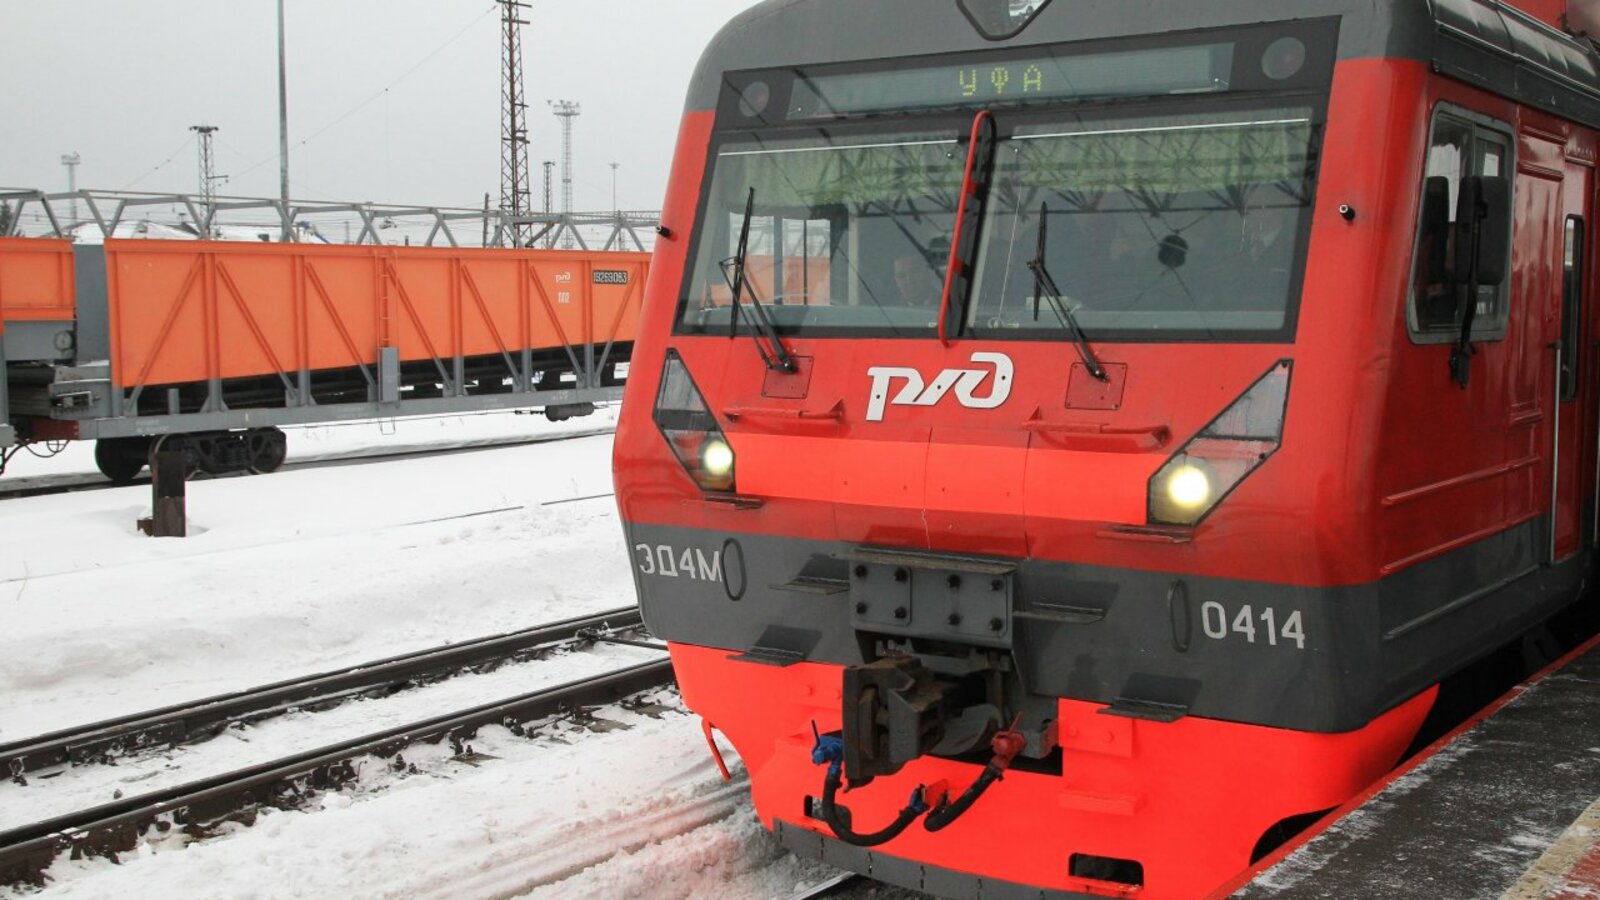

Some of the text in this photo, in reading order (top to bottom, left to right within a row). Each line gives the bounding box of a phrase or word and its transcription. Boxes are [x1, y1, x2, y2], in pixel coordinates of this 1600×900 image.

[959, 63, 1042, 96] УФА
[865, 351, 1014, 422] РЖД
[635, 543, 723, 582] ЭД4М
[1201, 600, 1306, 650] 0414
